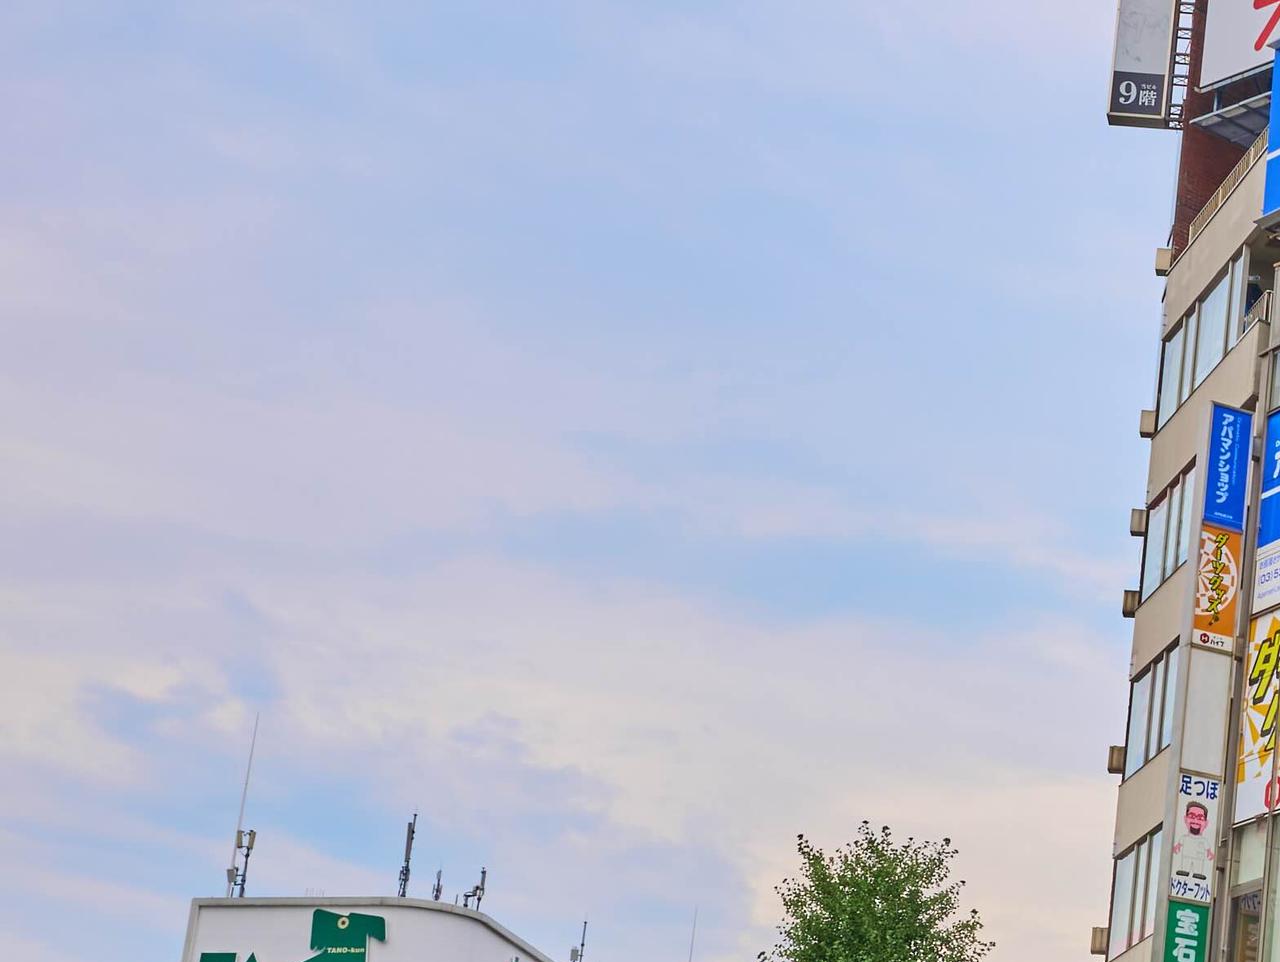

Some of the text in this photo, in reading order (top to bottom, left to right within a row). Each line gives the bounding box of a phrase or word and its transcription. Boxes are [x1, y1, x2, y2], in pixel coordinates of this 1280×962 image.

[1216, 413, 1235, 504] アパマンショップ
[1179, 774, 1218, 800] 足つぼ
[1171, 878, 1211, 901] ドクターフット
[327, 946, 365, 954] TANO-kun
